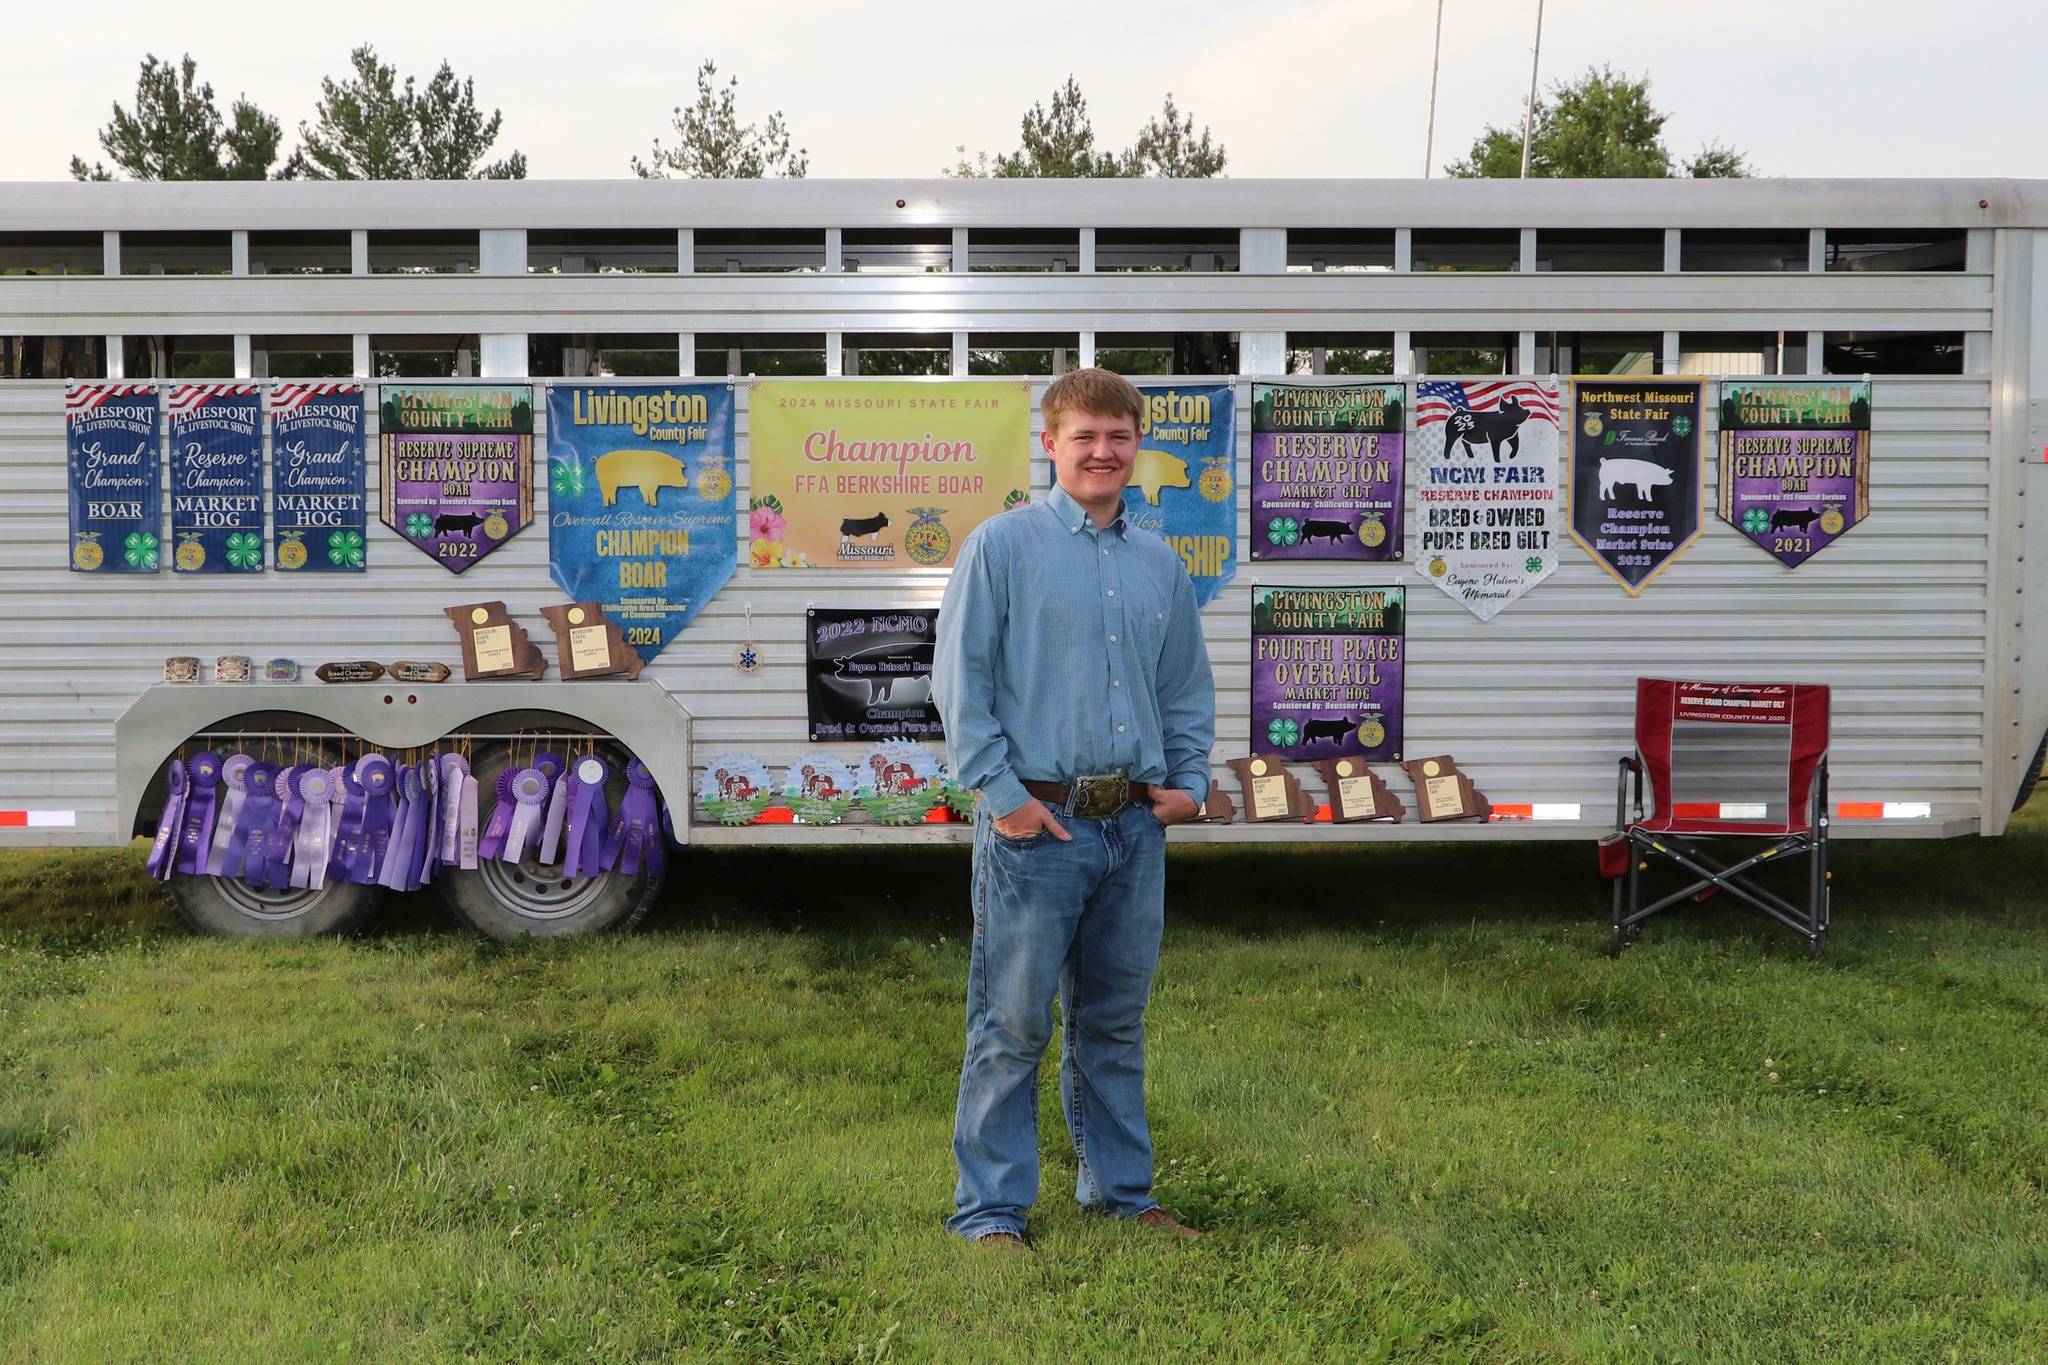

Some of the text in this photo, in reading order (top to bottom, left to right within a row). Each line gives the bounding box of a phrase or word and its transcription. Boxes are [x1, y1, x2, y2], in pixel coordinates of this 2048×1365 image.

[400, 390, 513, 409] LIVINGSTON
[780, 398, 999, 408] 2024 MISSOURI STATE FAIR
[1272, 389, 1386, 408] LIVINGSTON
[1581, 391, 1694, 403] Northwest Missouri
[1740, 387, 1851, 405] LIVINGSTON
[71, 406, 154, 429] JAMESPORT
[173, 406, 257, 430] JAMESPORT
[275, 405, 359, 429] JAMESPORT
[400, 412, 513, 428] COUNTY FAIR
[573, 389, 708, 436] Livingston
[1272, 410, 1384, 426] COUNTY FAIR
[1454, 414, 1472, 424] 20
[1610, 409, 1669, 420] State Fair
[1740, 408, 1851, 424] COUNTY FAIR
[75, 420, 151, 437] JR. LIVESTOCK SHOW
[177, 421, 253, 437] JR. LIVESTOCK SHOW
[279, 419, 355, 435] JR. LIVESTOCK SHOW
[1457, 422, 1476, 432] 23
[650, 427, 707, 444] County Fair
[1153, 427, 1210, 445] County Fair
[286, 440, 350, 467] Grand
[398, 441, 514, 459] RESERVE SUPREME
[803, 427, 978, 475] Champion
[1274, 435, 1379, 458] RESERVE
[1737, 437, 1851, 455] RESERVE SUPREME
[82, 441, 146, 468] Grand
[185, 442, 247, 467] Reserve
[396, 460, 516, 482] CHAMPION
[1261, 461, 1390, 483] CHAMPION
[1430, 467, 1545, 483] NCM FAIR
[1735, 457, 1852, 477] CHAMPION
[84, 469, 145, 491] Champion
[186, 469, 247, 491] Champion
[287, 468, 349, 490] Champion
[795, 475, 984, 494] FFA BERKSHIRE BOAR
[1781, 479, 1807, 491] BOAR
[443, 484, 470, 496] BOAR
[1280, 485, 1372, 498] MARKET GILT
[1421, 489, 1553, 501] RESERVE CHAMPION
[1741, 493, 1771, 501] Sponsored
[88, 503, 142, 518] BOAR
[175, 497, 259, 511] MARKET
[277, 496, 361, 511] MARKET
[1262, 501, 1300, 509] Sponsored
[1301, 501, 1312, 509] by:
[1314, 500, 1353, 508] Chillicothe
[195, 512, 241, 526] HOG
[296, 511, 342, 525] HOG
[552, 511, 732, 527] Over-all Reserve Supreme
[1429, 508, 1545, 527] BRED & OWNED
[1607, 508, 1664, 519] Reserve
[1600, 523, 1670, 537] Champion
[596, 530, 689, 557] CHAMPION
[1424, 531, 1550, 550] PURE BRED GILT
[1596, 539, 1674, 550] Market Swine
[1774, 538, 1812, 552] 2021
[438, 543, 477, 557] 2022
[837, 543, 894, 556] Missouri
[1618, 555, 1651, 566] 2022
[620, 561, 667, 588] BOAR
[1446, 574, 1479, 587] Eugene
[1272, 591, 1386, 610] LIVINGSTON
[1462, 587, 1511, 600] Memorial
[1272, 612, 1384, 628] COUNTY FAIR
[628, 628, 660, 645] 2024
[816, 615, 928, 643] 2022 NCMO
[1258, 638, 1399, 661] FOURTH PLACE
[849, 662, 910, 674] Eugene Hutson's
[1274, 663, 1381, 685] OVERALL
[1284, 688, 1371, 700] MARKET HOG
[1689, 684, 1719, 693] Memory
[1721, 686, 1731, 694] of
[1273, 702, 1381, 710] Sponsored by: Heussner Farms
[1680, 697, 1704, 705] RESERVE
[1704, 698, 1722, 706] GRAND
[1723, 699, 1750, 707] CHAMPION
[1751, 700, 1772, 708] MARKET
[867, 708, 925, 720] Champion
[816, 722, 927, 734] Bred & Owned Pure
